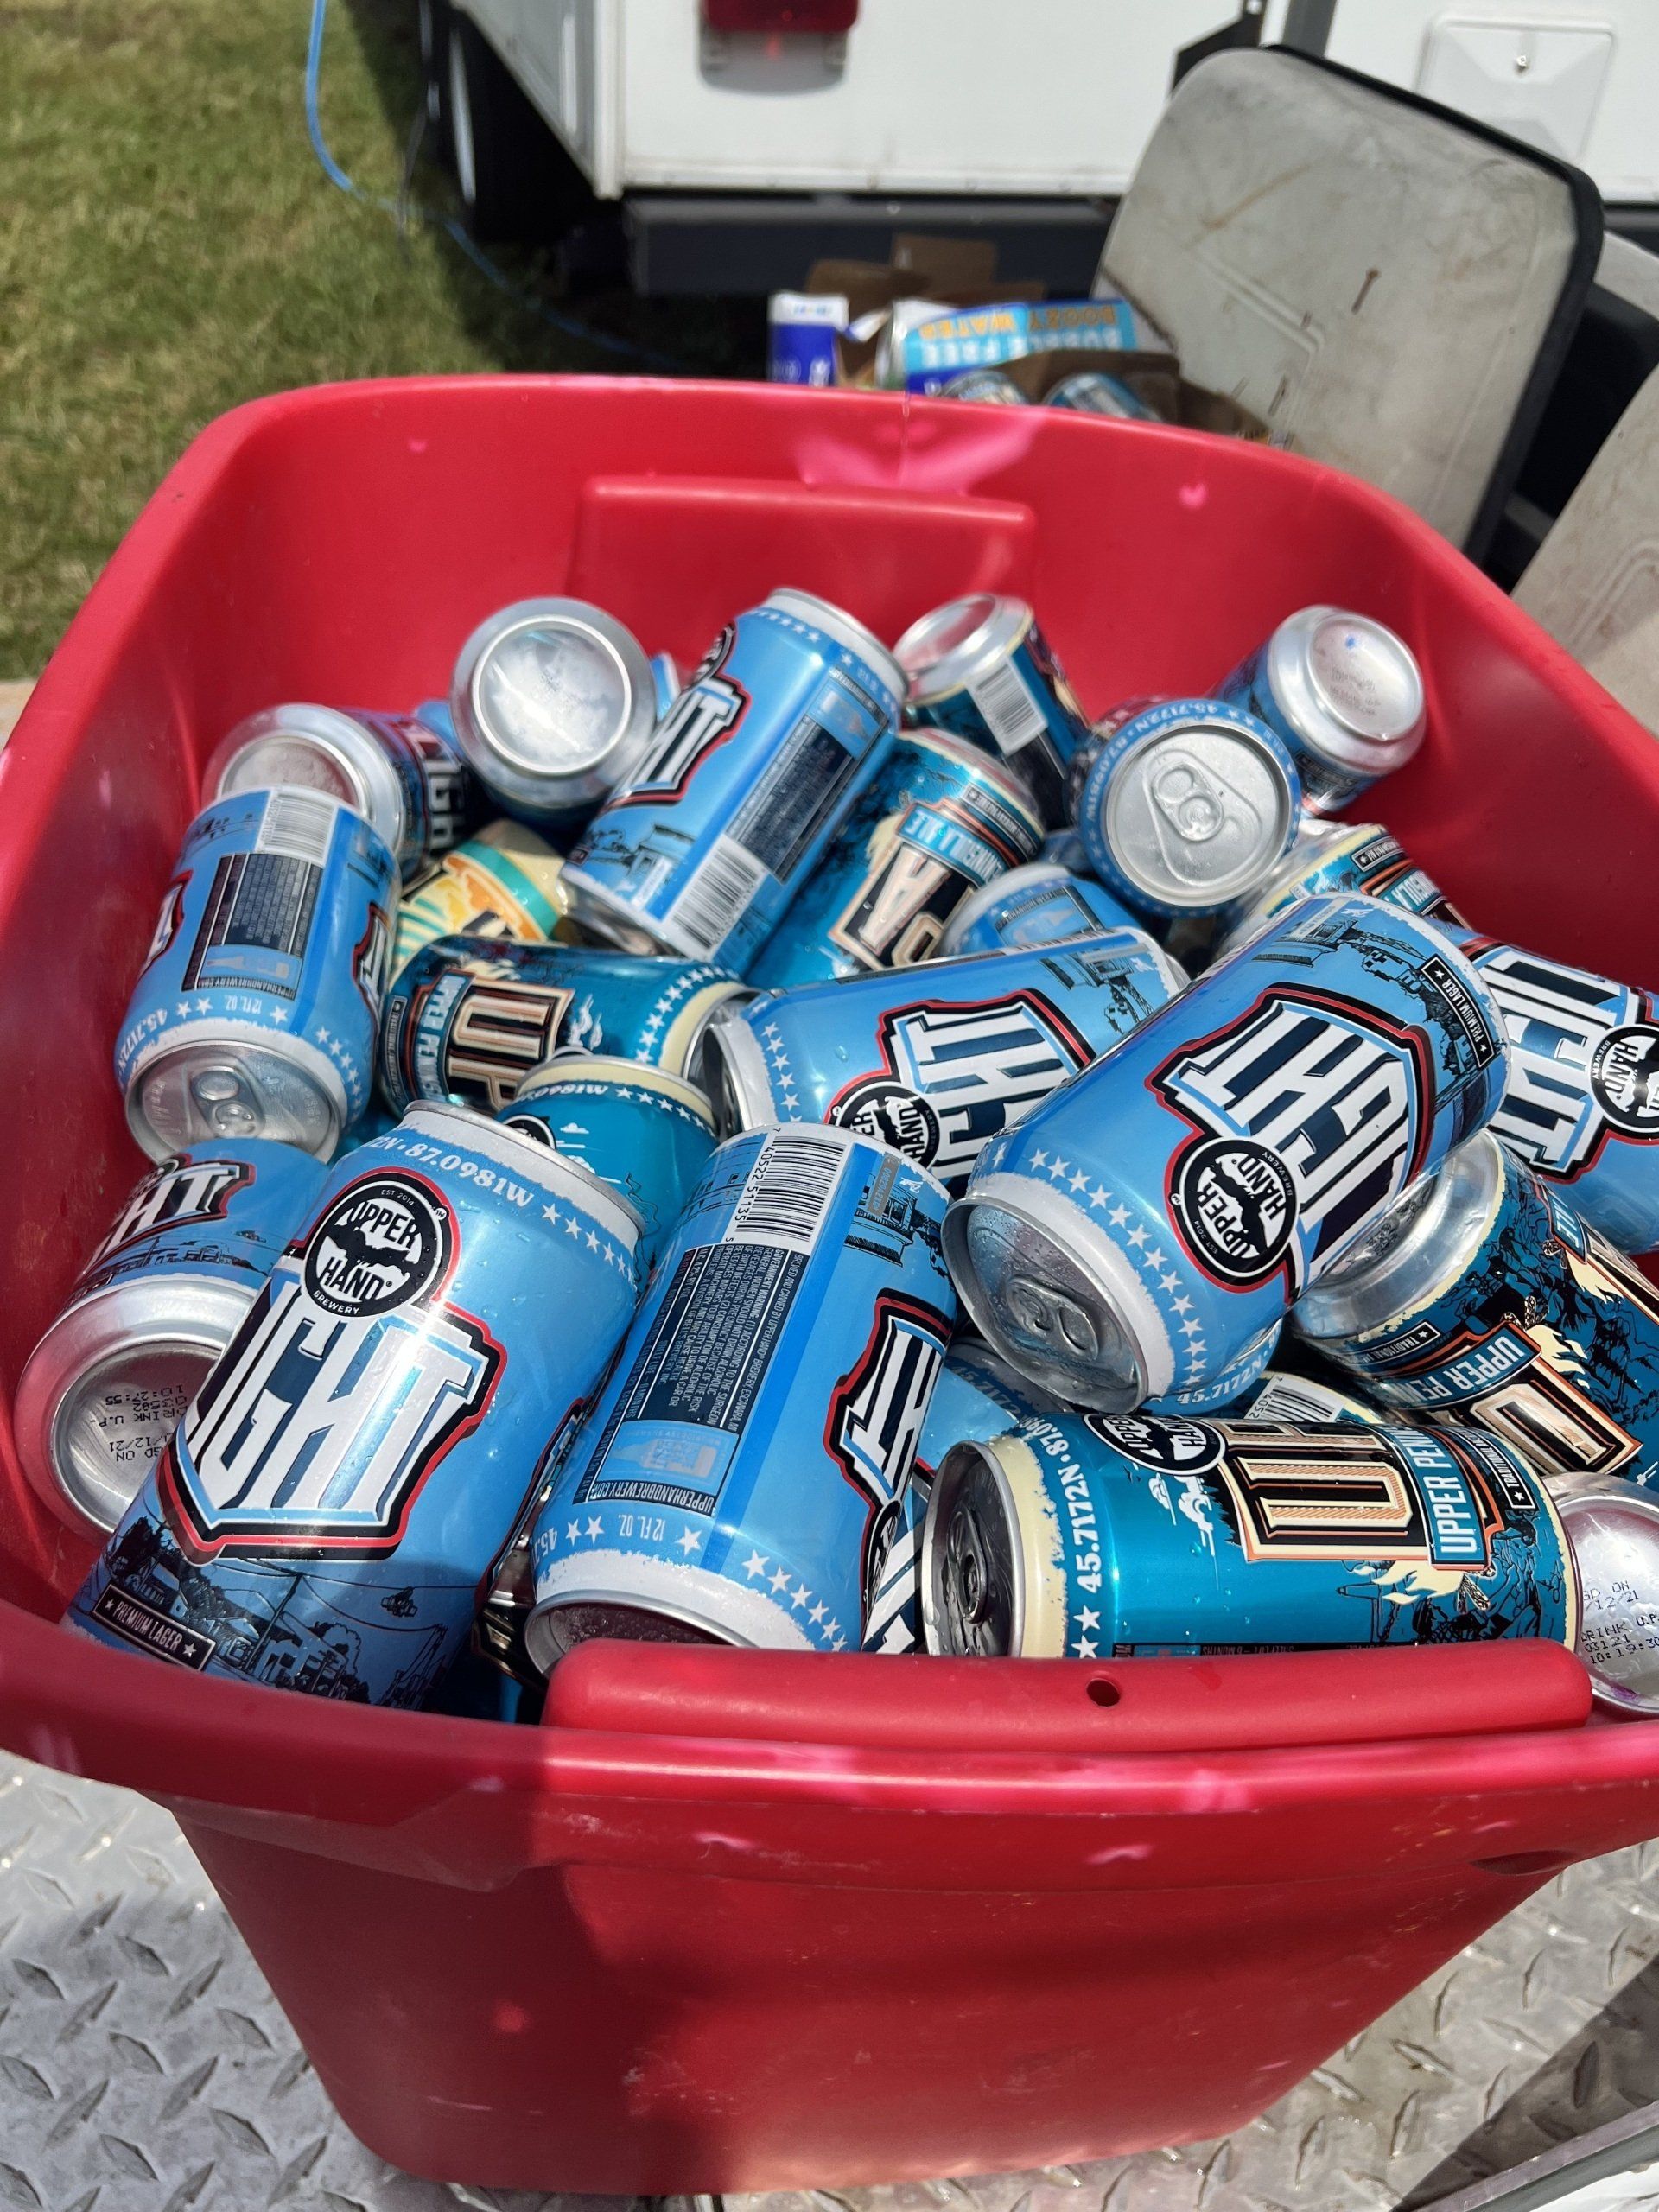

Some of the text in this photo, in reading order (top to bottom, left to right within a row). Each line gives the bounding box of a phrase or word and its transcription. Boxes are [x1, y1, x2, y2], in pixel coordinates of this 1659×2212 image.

[1440, 977, 1484, 1042] PREMIUM LAGER
[1604, 1041, 1638, 1093] HAND
[405, 1144, 536, 1209] 87.0981W
[751, 1146, 774, 1180] 40522
[1261, 1150, 1294, 1196] BREWERY
[397, 1191, 414, 1205] 2014
[1236, 1153, 1287, 1220] HAND
[736, 1185, 757, 1223] 51135
[347, 1200, 418, 1249] UPPER
[1193, 1183, 1251, 1260] UPPER
[715, 1243, 734, 1270] OPERATE
[721, 1243, 743, 1280] BEVERAGES
[734, 1252, 749, 1272] BIRTH
[741, 1244, 764, 1281] BEVERAGES
[760, 1248, 784, 1290] GOVERNMENT
[785, 1253, 803, 1278] BREWED
[318, 1256, 382, 1300] HAND
[710, 1278, 728, 1305] IMPAIRS
[732, 1279, 749, 1304] DURING
[745, 1274, 762, 1300] WOMEN
[781, 1275, 794, 1289] AND
[312, 1290, 359, 1313] BREWERY
[695, 1306, 708, 1320] AND
[703, 1302, 718, 1321] YOUR
[734, 1298, 753, 1325] SHOULD
[747, 1287, 768, 1320] WARNING:
[772, 1287, 790, 1312] CANNED
[693, 1319, 711, 1345] ABILITY
[700, 1308, 727, 1356] CONSUMPTION
[716, 1302, 740, 1343] PREGNANCY
[728, 1323, 742, 1338] NOT
[761, 1318, 778, 1340] UPPER
[679, 1333, 696, 1357] CAUSE
[704, 1340, 724, 1372] BECAUSE
[721, 1337, 737, 1359] DRINK
[728, 1329, 752, 1368] ACCORDING
[669, 1356, 686, 1382] HEALTH
[681, 1353, 697, 1375] DRIVE
[705, 1357, 728, 1396] ALCOHOLIC
[1442, 1333, 1523, 1394] UPPER
[672, 1380, 686, 1396] CAR
[680, 1363, 703, 1402] ALCOHOLIC
[694, 1380, 708, 1396] THE
[718, 1376, 733, 1393] THE
[667, 1395, 680, 1408] OR
[687, 1395, 702, 1414] RISK
[705, 1391, 728, 1426] SURGEON
[116, 1450, 135, 1462] ON
[1057, 1463, 1103, 1594] 45.7172N
[1421, 1477, 1478, 1554] UPPER
[654, 1518, 664, 1541] 12
[112, 1602, 183, 1649] PREMIUM LAGER
[1580, 1621, 1628, 1642] DRINK
